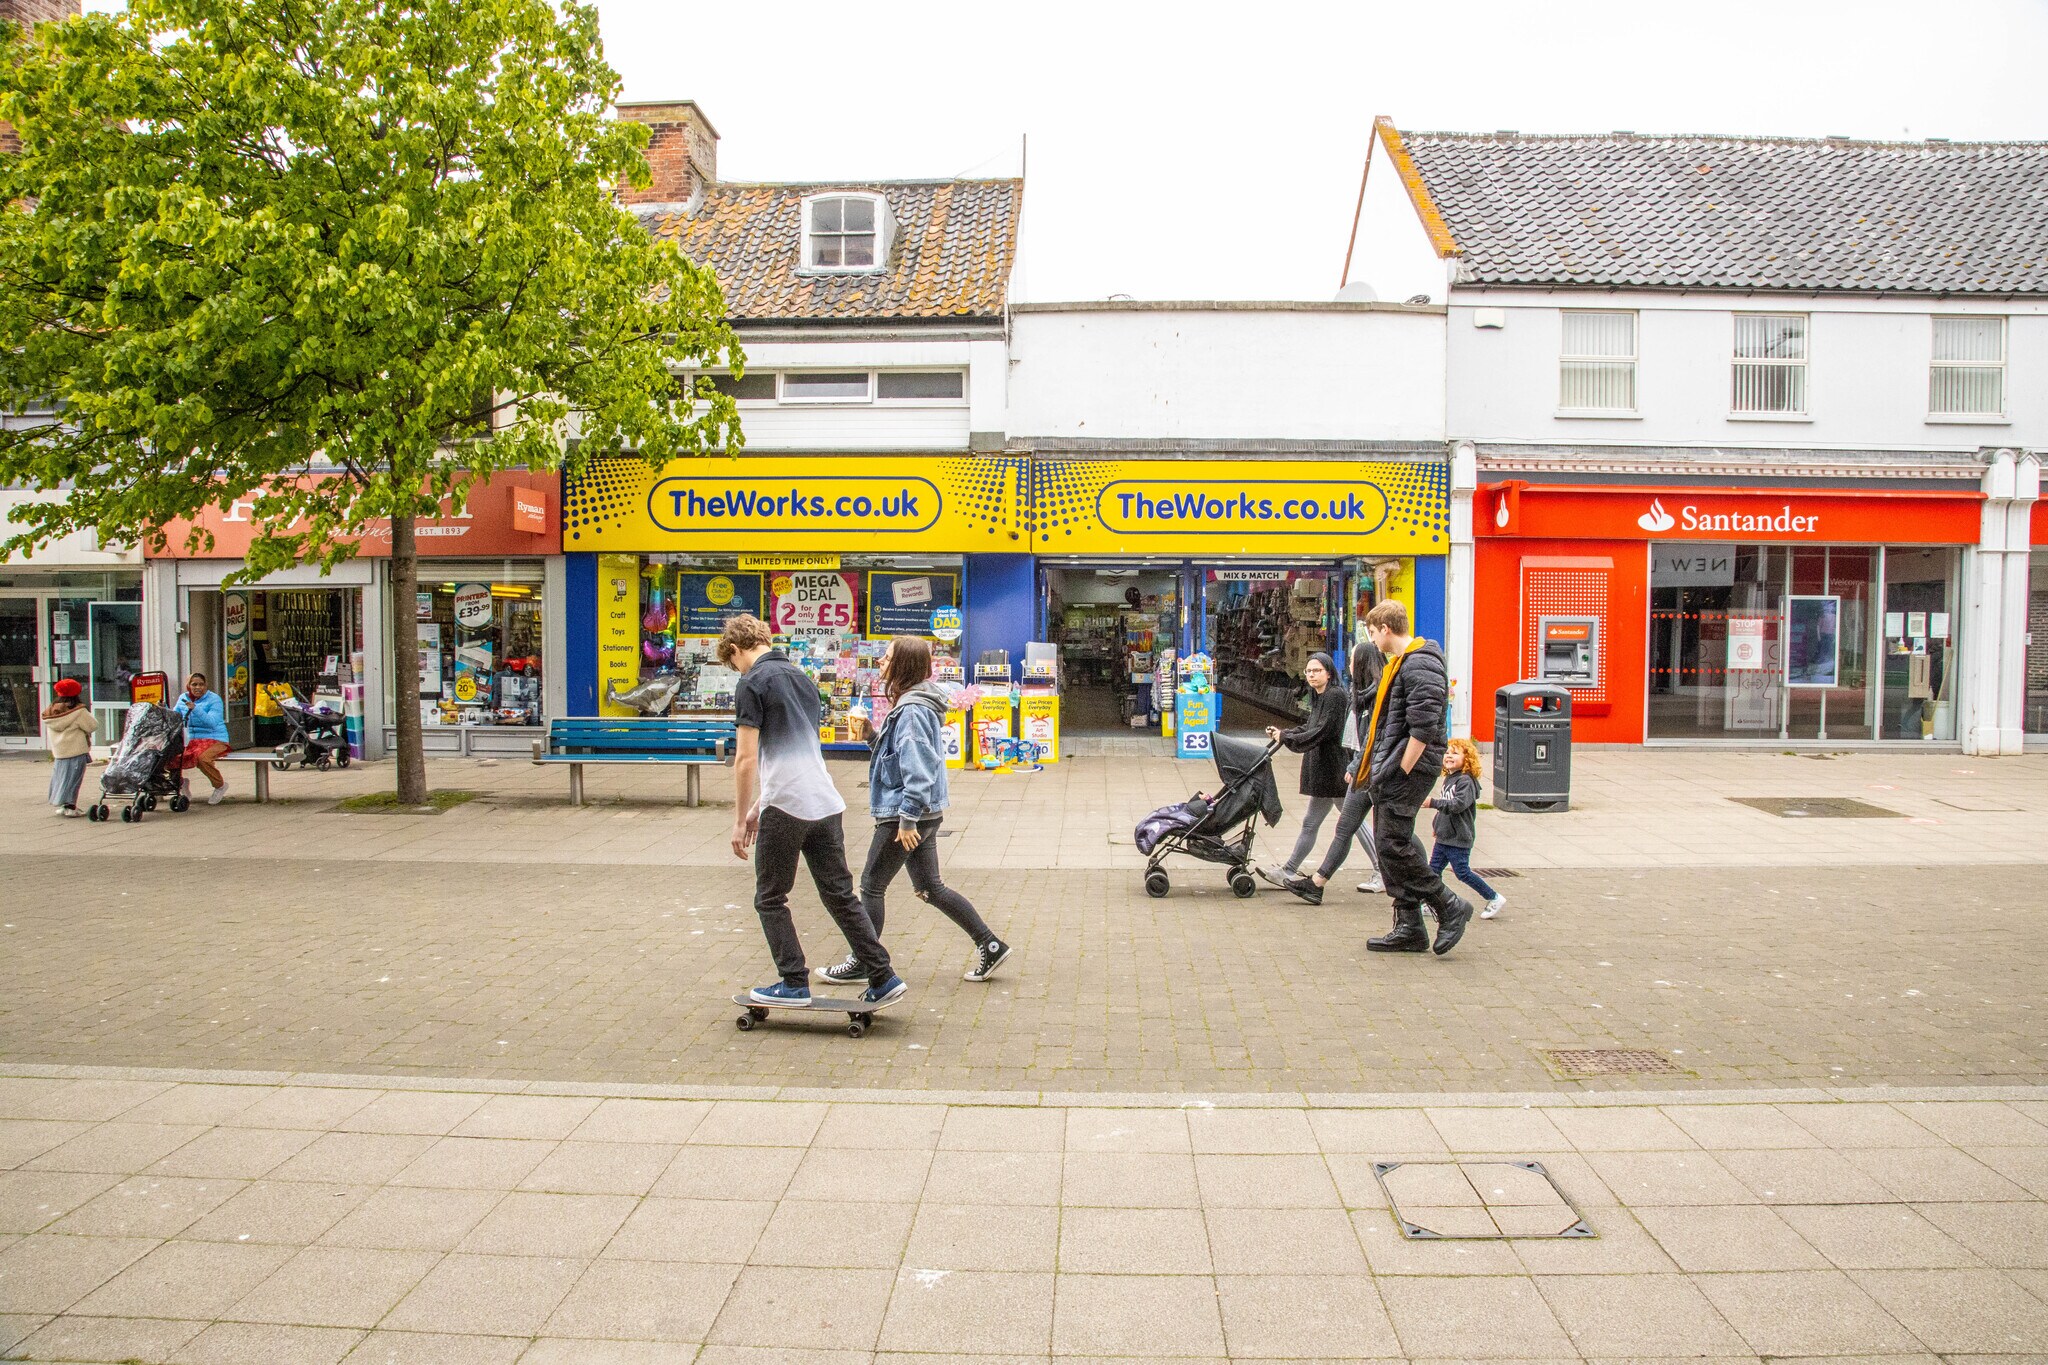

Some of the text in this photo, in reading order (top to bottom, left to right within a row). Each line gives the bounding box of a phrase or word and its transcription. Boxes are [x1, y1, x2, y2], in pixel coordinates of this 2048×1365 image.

[517, 501, 545, 514] Ryman
[669, 489, 919, 517] TheWorks.co.uk
[1117, 492, 1366, 520] TheWorks.co.uk
[1681, 505, 1819, 532] Santander
[441, 527, 462, 535] 1893
[745, 557, 781, 565] LIMITED
[783, 557, 804, 565] TIME
[1223, 572, 1280, 580] MIX & MATCH
[794, 575, 840, 588] MEGA
[1829, 578, 1865, 586] Welcome
[456, 591, 489, 602] PRINTERS
[798, 588, 836, 601] DEAL
[901, 591, 924, 599] Rewards
[780, 603, 796, 625] 2
[798, 611, 815, 619] only
[817, 603, 850, 627] £5
[933, 617, 961, 629] DAD
[1735, 620, 1756, 628] STOP
[611, 628, 625, 636] Toys
[603, 645, 634, 653] Stationery
[136, 678, 160, 686] Ryman
[1187, 700, 1204, 709] Fun
[1183, 709, 1209, 717] for all
[1183, 717, 1209, 727] Ages!
[1185, 734, 1209, 749] £3
